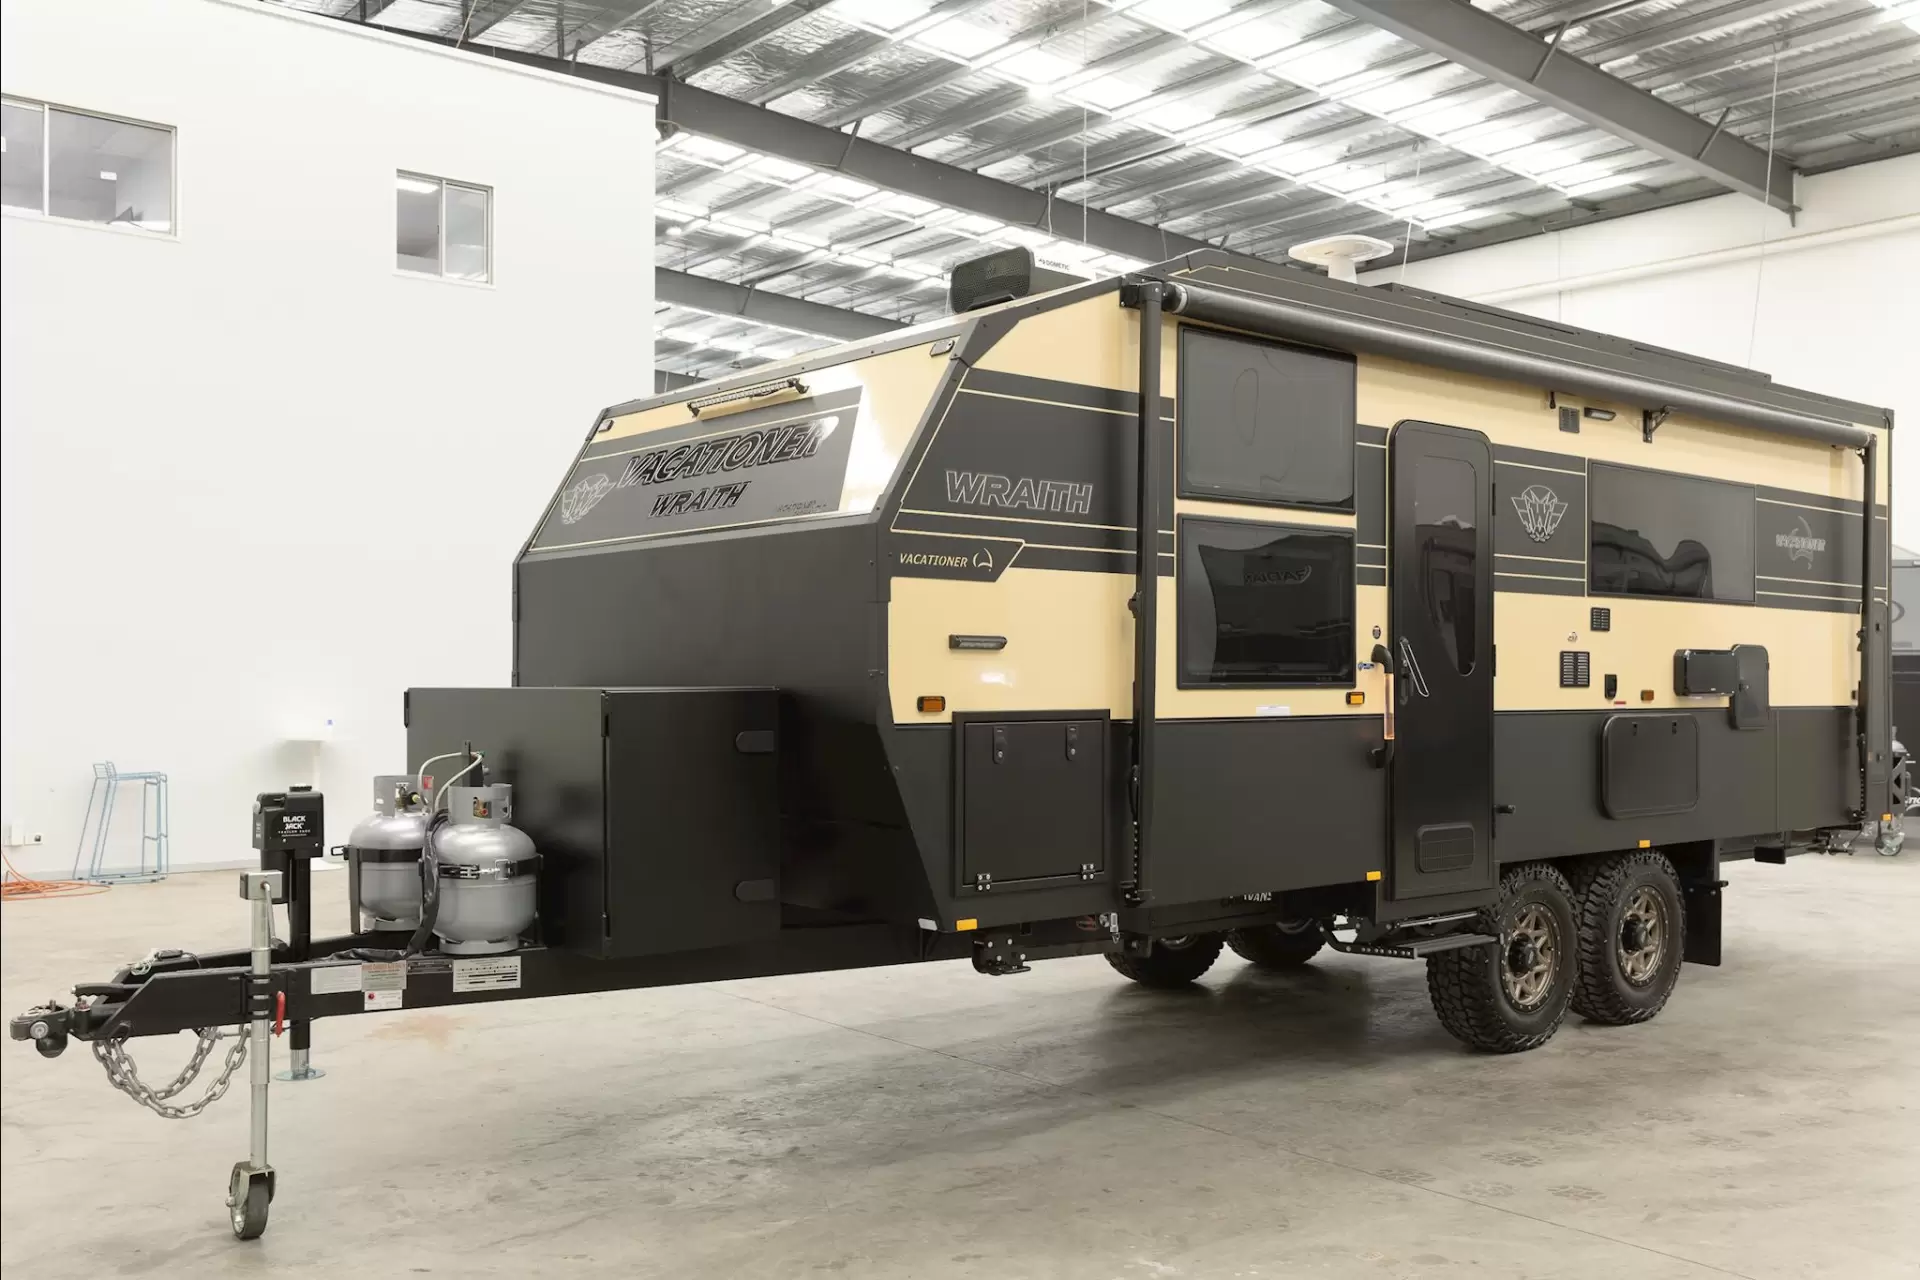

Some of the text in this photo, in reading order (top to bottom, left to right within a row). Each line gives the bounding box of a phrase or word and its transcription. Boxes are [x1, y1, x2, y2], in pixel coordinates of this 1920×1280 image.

[615, 419, 830, 489] VACATIONER
[648, 480, 753, 518] WRAITH
[945, 469, 1093, 515] WRAITH
[899, 552, 968, 568] VACATIONER
[282, 815, 306, 823] BLACK
